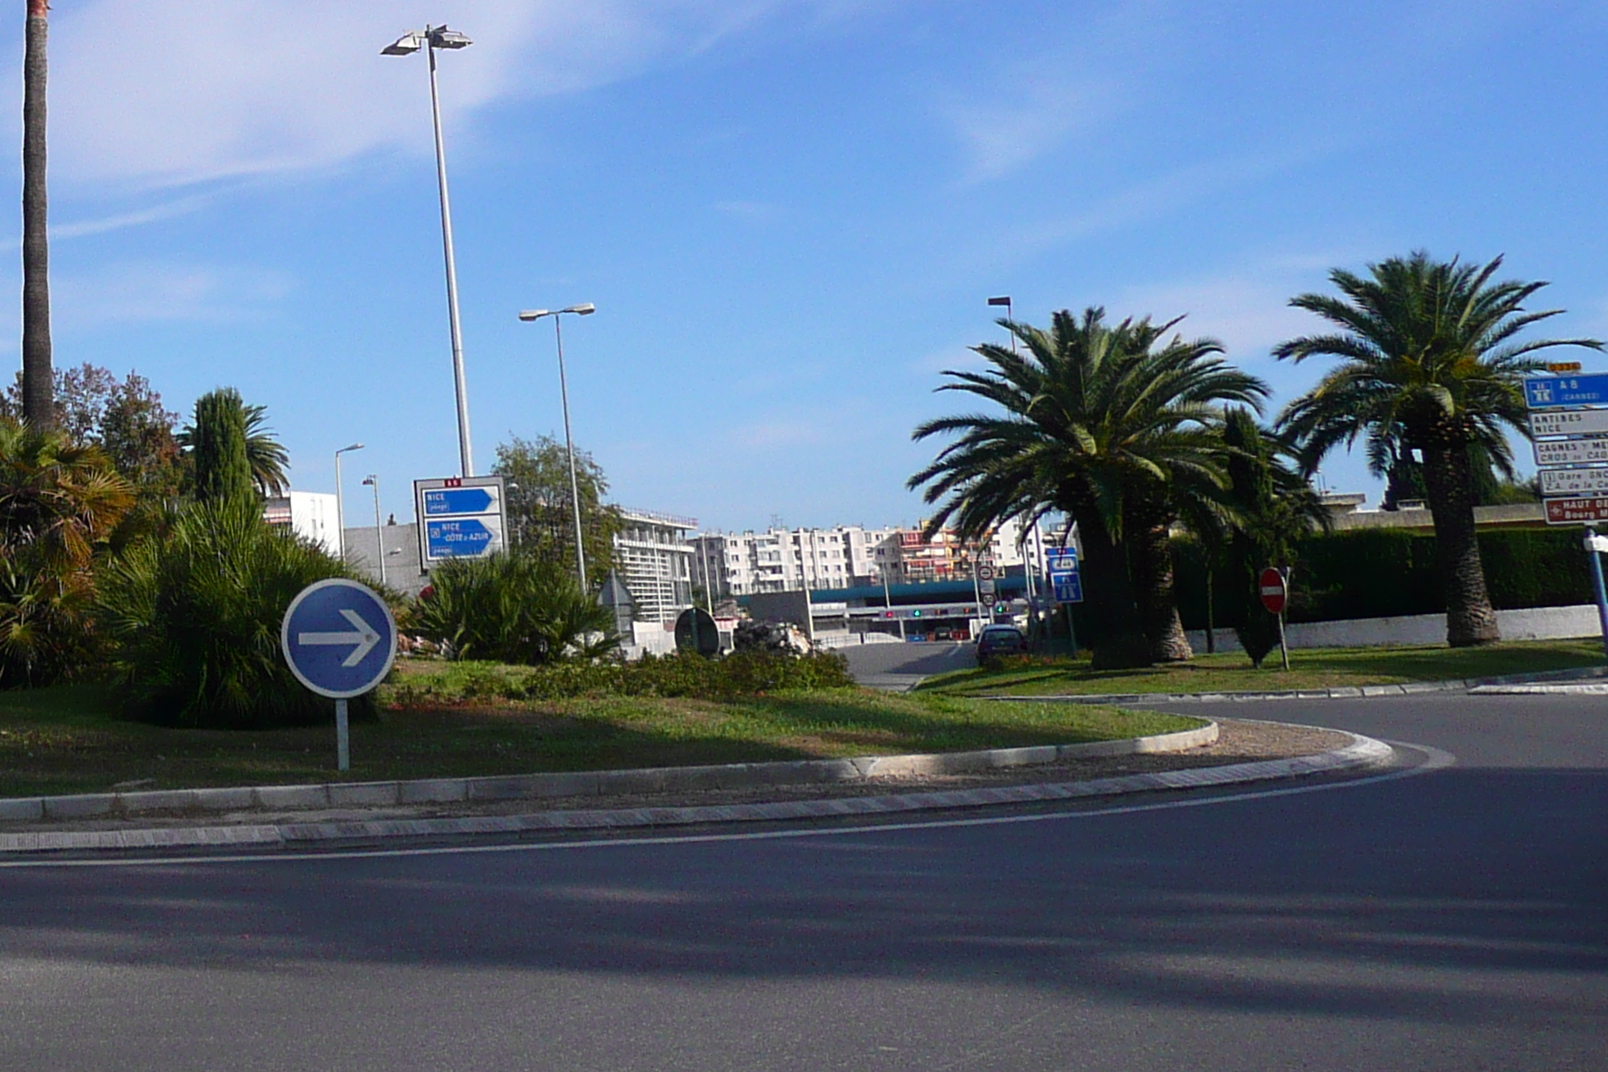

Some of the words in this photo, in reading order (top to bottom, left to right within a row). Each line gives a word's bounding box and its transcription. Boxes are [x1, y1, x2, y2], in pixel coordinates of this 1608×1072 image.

[1534, 414, 1582, 424] ANTIBES
[1535, 425, 1561, 433] NICE
[1538, 443, 1578, 453] CAGNES
[1540, 453, 1568, 462] CROS
[1558, 473, 1582, 481] Gare
[427, 493, 445, 501] NICE
[1563, 500, 1590, 509] HAUT
[1565, 511, 1595, 520] Bourg
[442, 523, 460, 531] NICE
